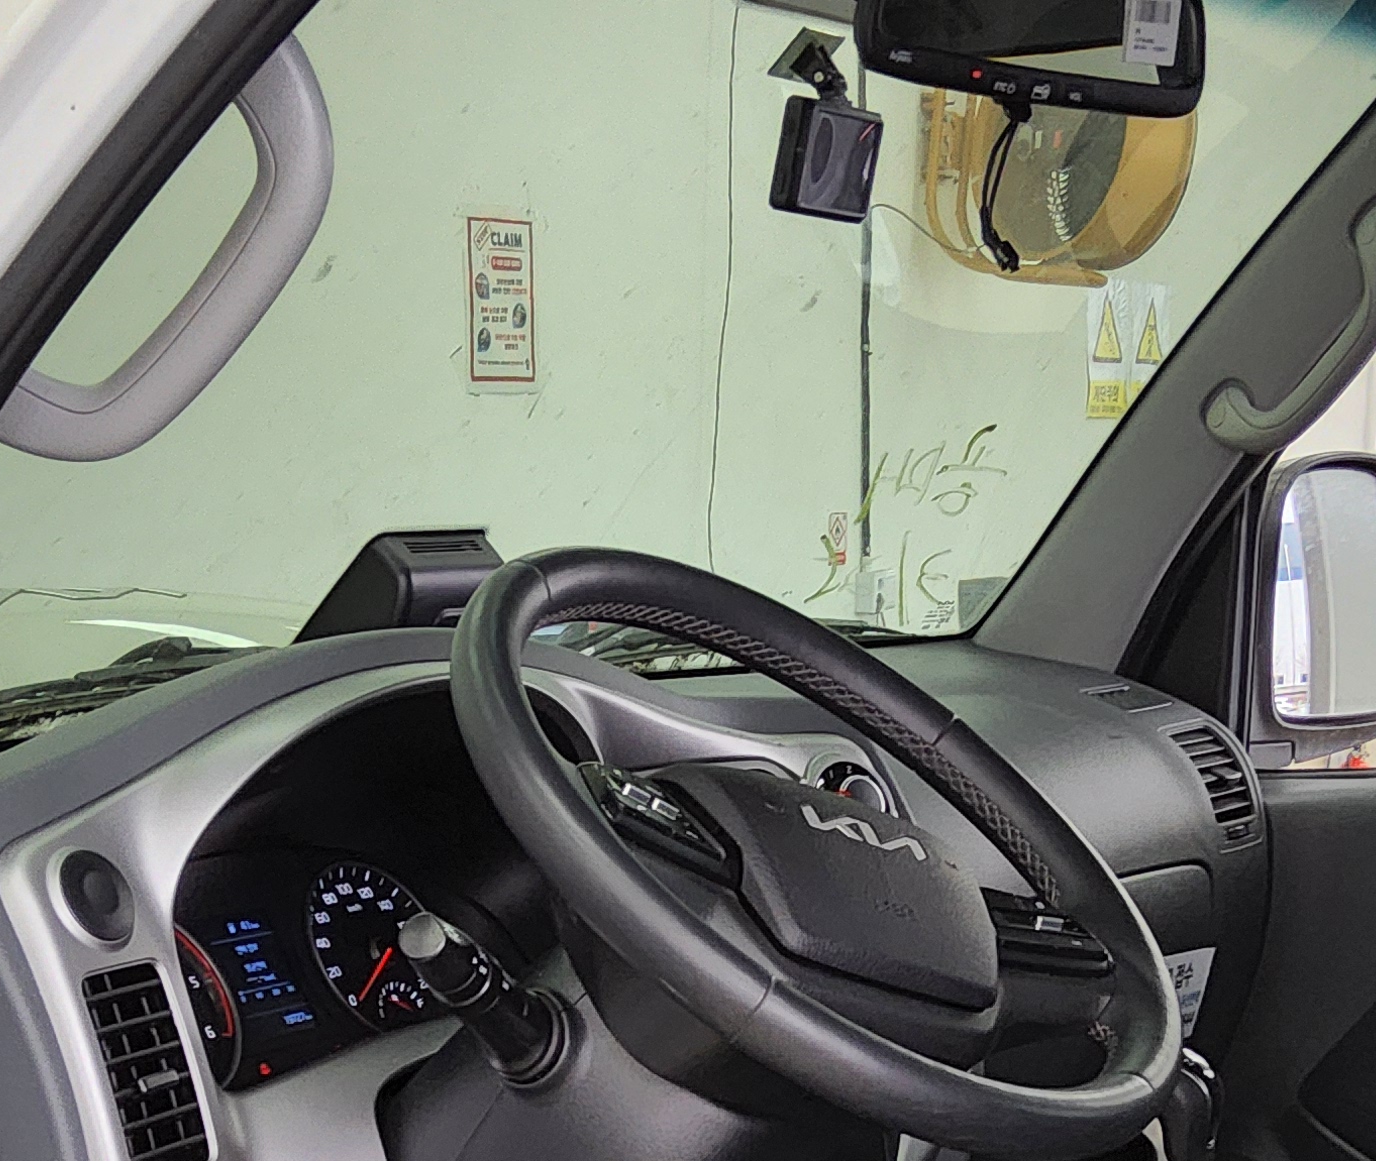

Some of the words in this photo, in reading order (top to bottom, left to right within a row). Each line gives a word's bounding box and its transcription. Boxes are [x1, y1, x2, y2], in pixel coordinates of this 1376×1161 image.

[491, 231, 522, 248] CLAIM
[845, 765, 853, 774] 2
[322, 892, 338, 905] 80
[314, 912, 330, 924] 60
[316, 937, 331, 949] 40
[327, 965, 342, 979] 20
[188, 975, 200, 989] 5
[348, 994, 357, 1007] 0
[204, 1025, 216, 1039] 6
